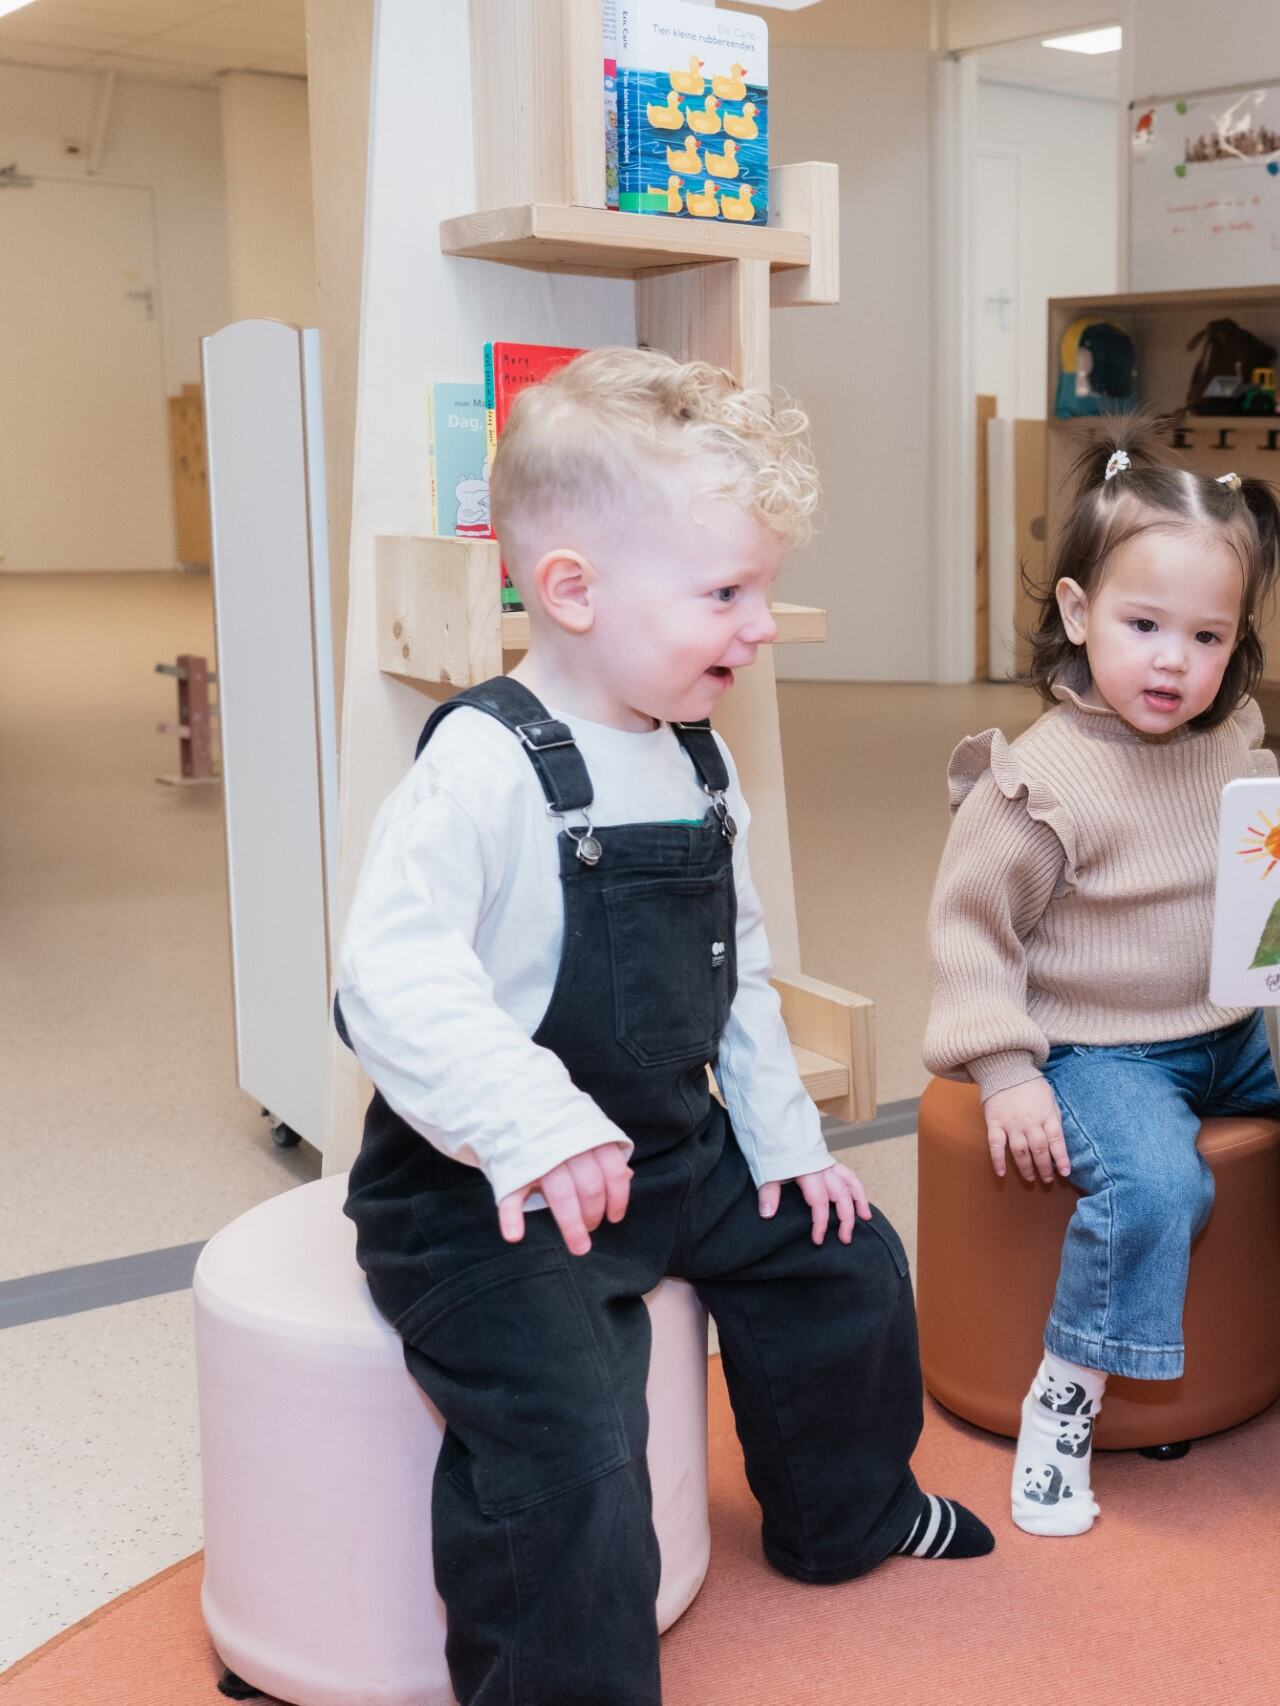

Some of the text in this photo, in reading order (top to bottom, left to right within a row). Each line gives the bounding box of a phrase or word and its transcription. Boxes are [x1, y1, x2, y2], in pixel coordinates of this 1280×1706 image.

[652, 23, 756, 53] Tien kleine rubbereendjes
